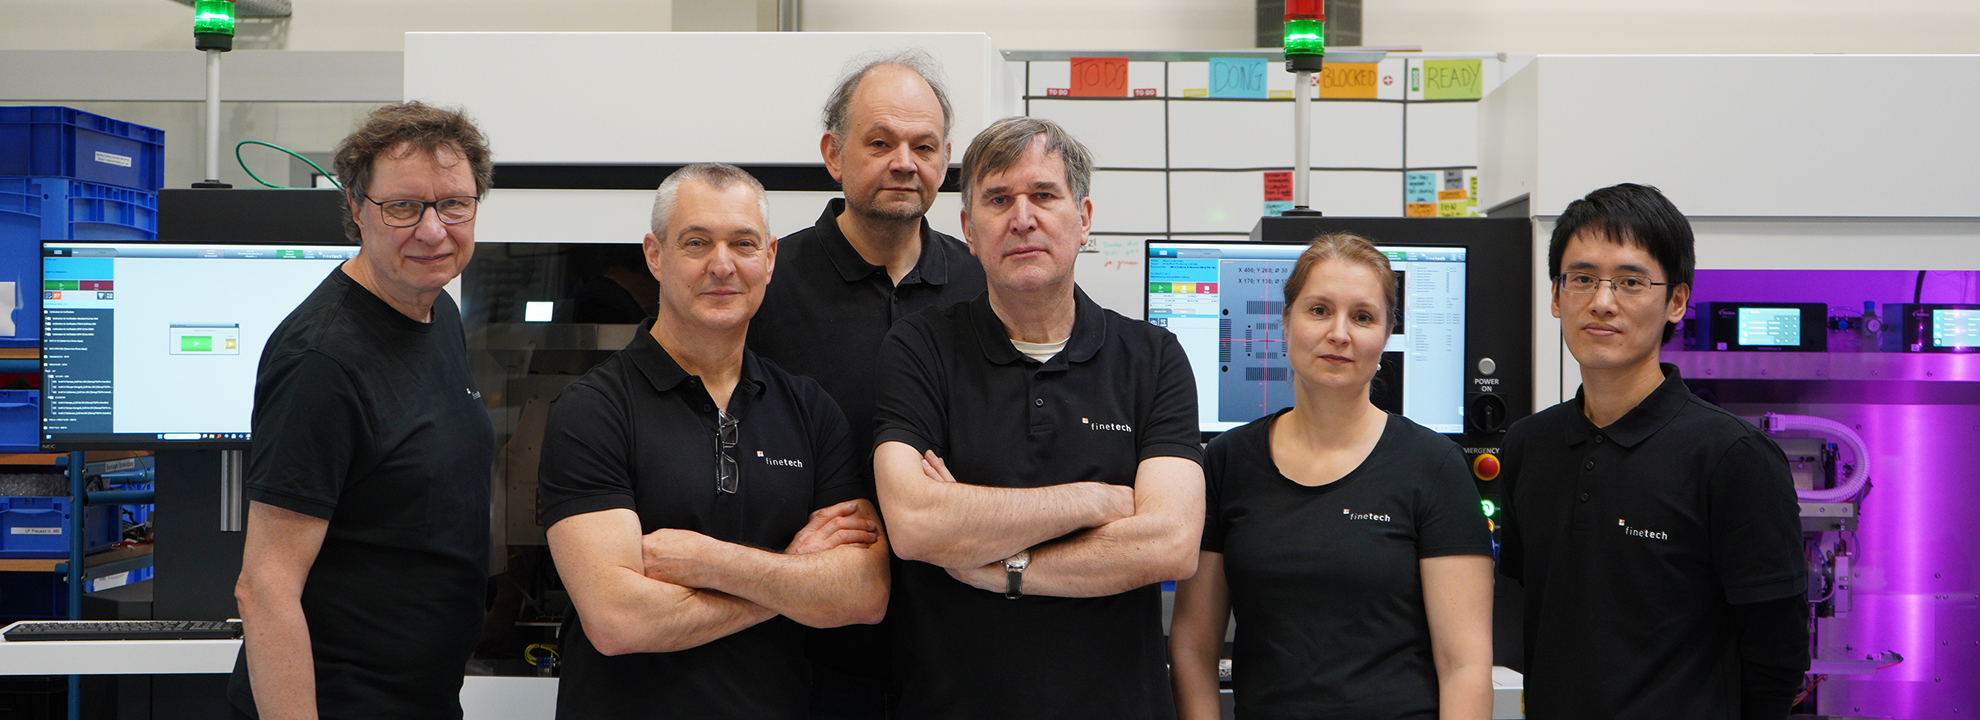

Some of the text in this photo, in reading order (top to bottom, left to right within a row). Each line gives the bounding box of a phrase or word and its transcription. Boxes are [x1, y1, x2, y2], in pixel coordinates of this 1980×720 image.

[1323, 66, 1377, 88] BLOCKED
[1428, 62, 1481, 93] READY
[1091, 422, 1132, 433] finetech
[765, 457, 803, 468] finetech
[1350, 512, 1391, 522] finetech
[1625, 526, 1668, 540] finetech
